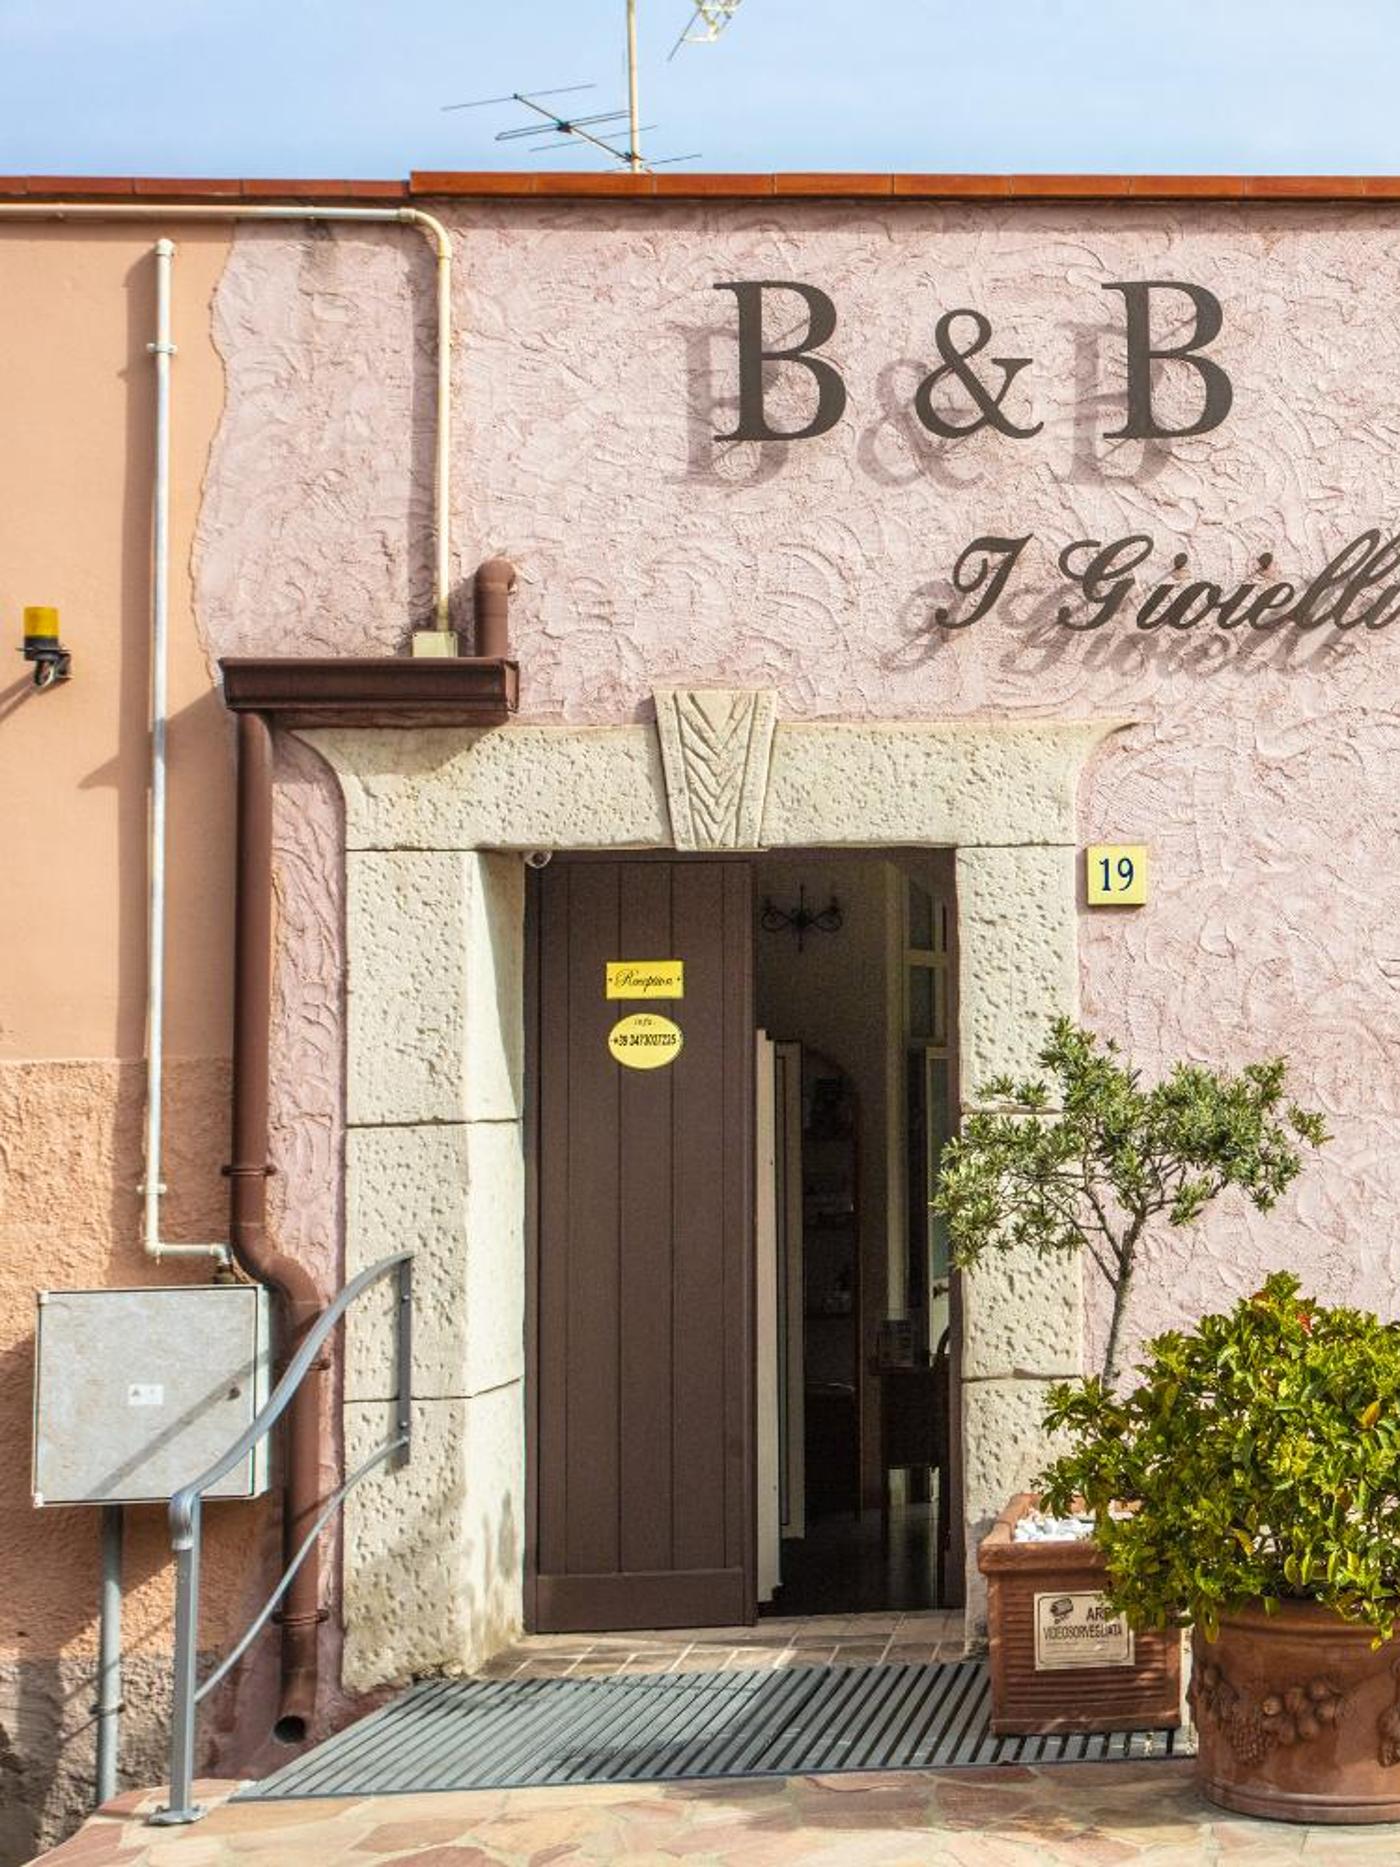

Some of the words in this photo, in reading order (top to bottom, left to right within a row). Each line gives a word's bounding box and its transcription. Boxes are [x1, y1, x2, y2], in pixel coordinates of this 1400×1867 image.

[712, 281, 847, 442] B
[914, 308, 1045, 439] &
[1100, 281, 1233, 441] B
[1099, 857, 1134, 891] 19
[1086, 1606, 1113, 1621] AR
